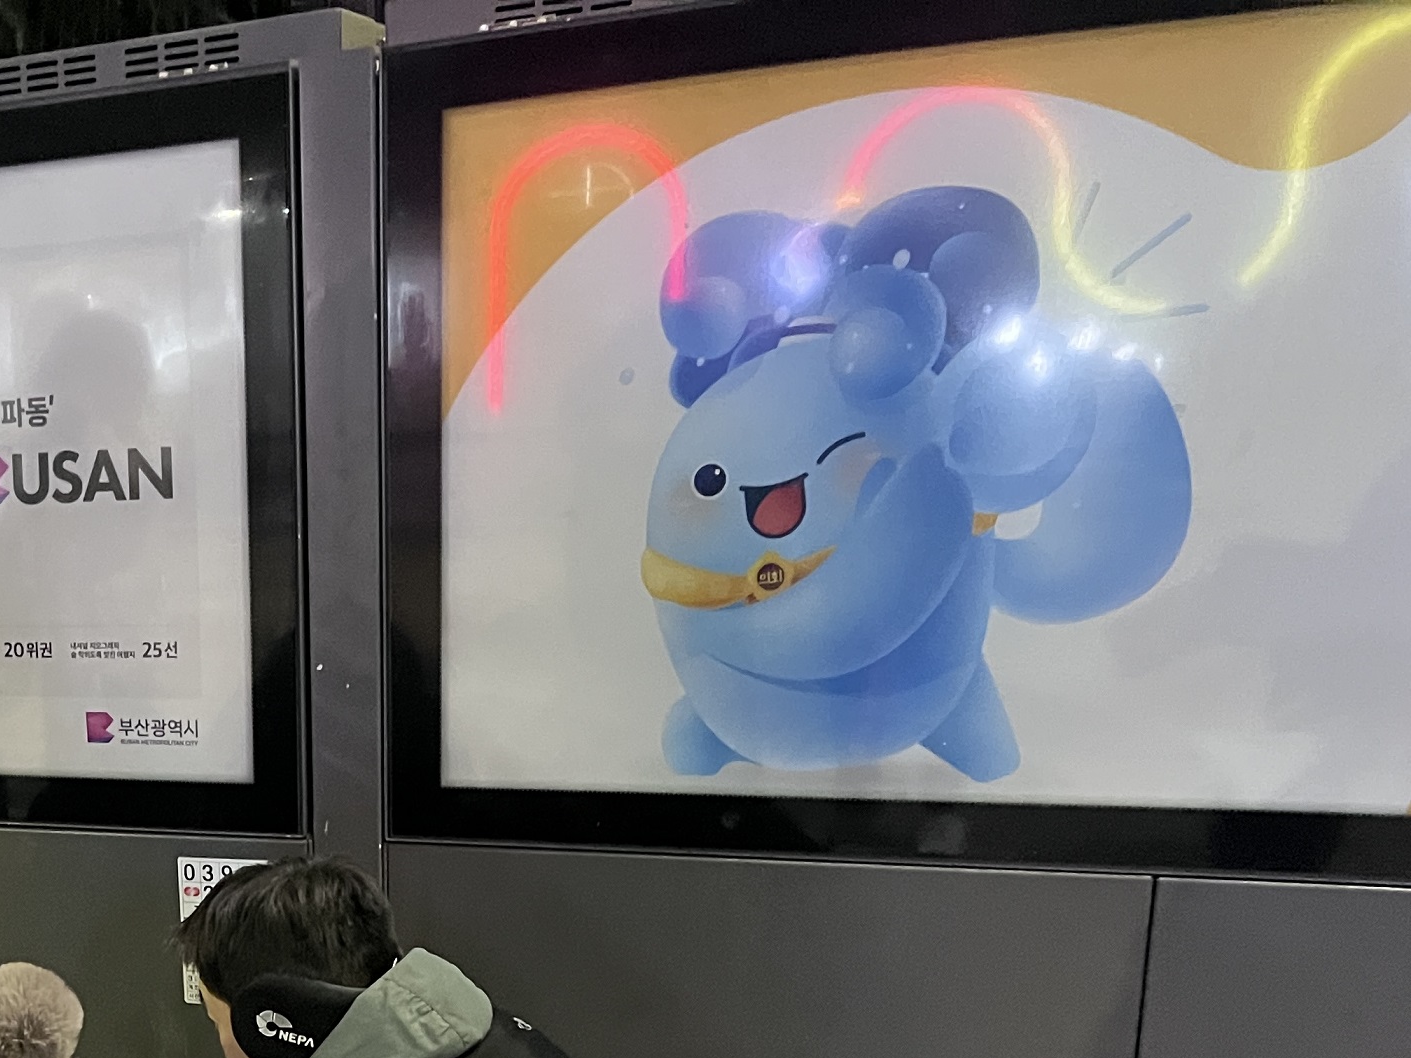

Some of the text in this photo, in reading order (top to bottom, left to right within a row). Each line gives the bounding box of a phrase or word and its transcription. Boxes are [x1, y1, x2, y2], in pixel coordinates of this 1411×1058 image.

[3, 641, 53, 659] 20위권
[142, 641, 179, 659] 25선
[119, 718, 198, 738] 부산광역시
[279, 1029, 315, 1048] NEPA
